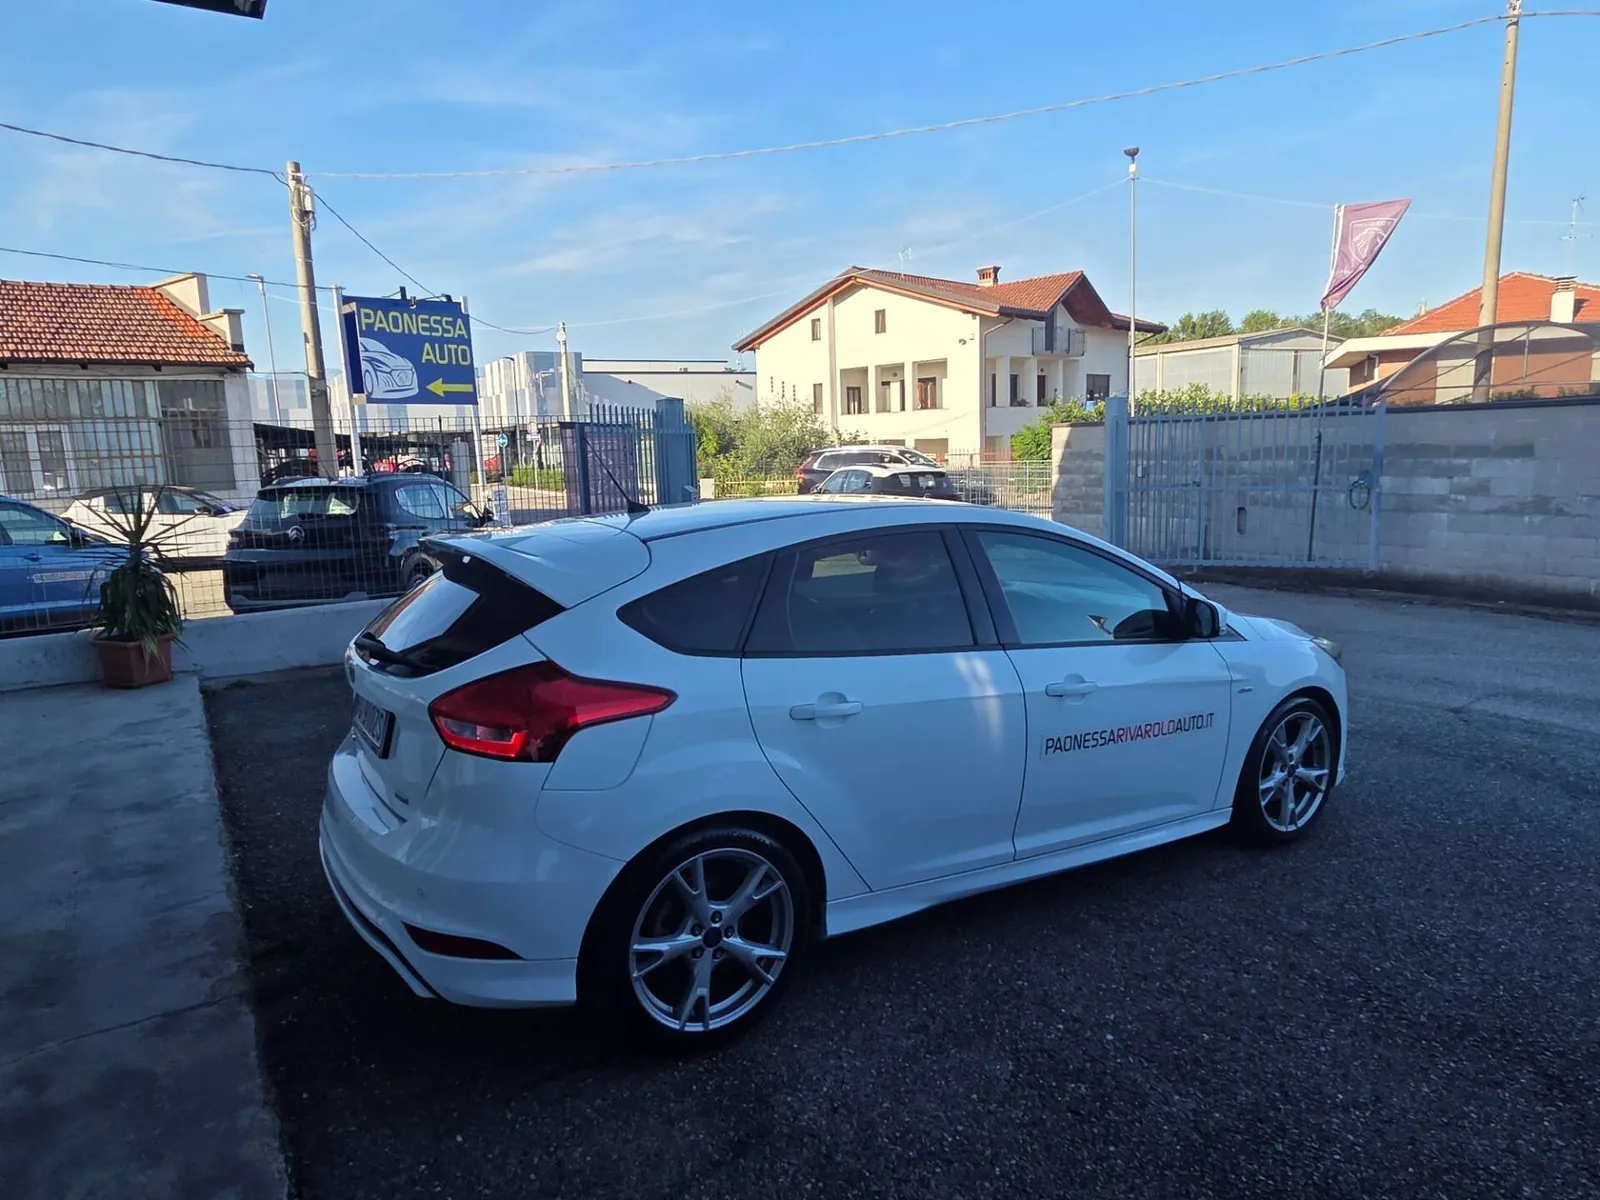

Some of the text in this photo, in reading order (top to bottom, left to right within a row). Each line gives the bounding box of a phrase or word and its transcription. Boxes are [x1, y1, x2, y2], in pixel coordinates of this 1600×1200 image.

[360, 308, 468, 339] PAONESSA
[421, 342, 471, 366] AUTO
[1045, 712, 1214, 755] PAONESSARIVAROLOAUTO.IT
